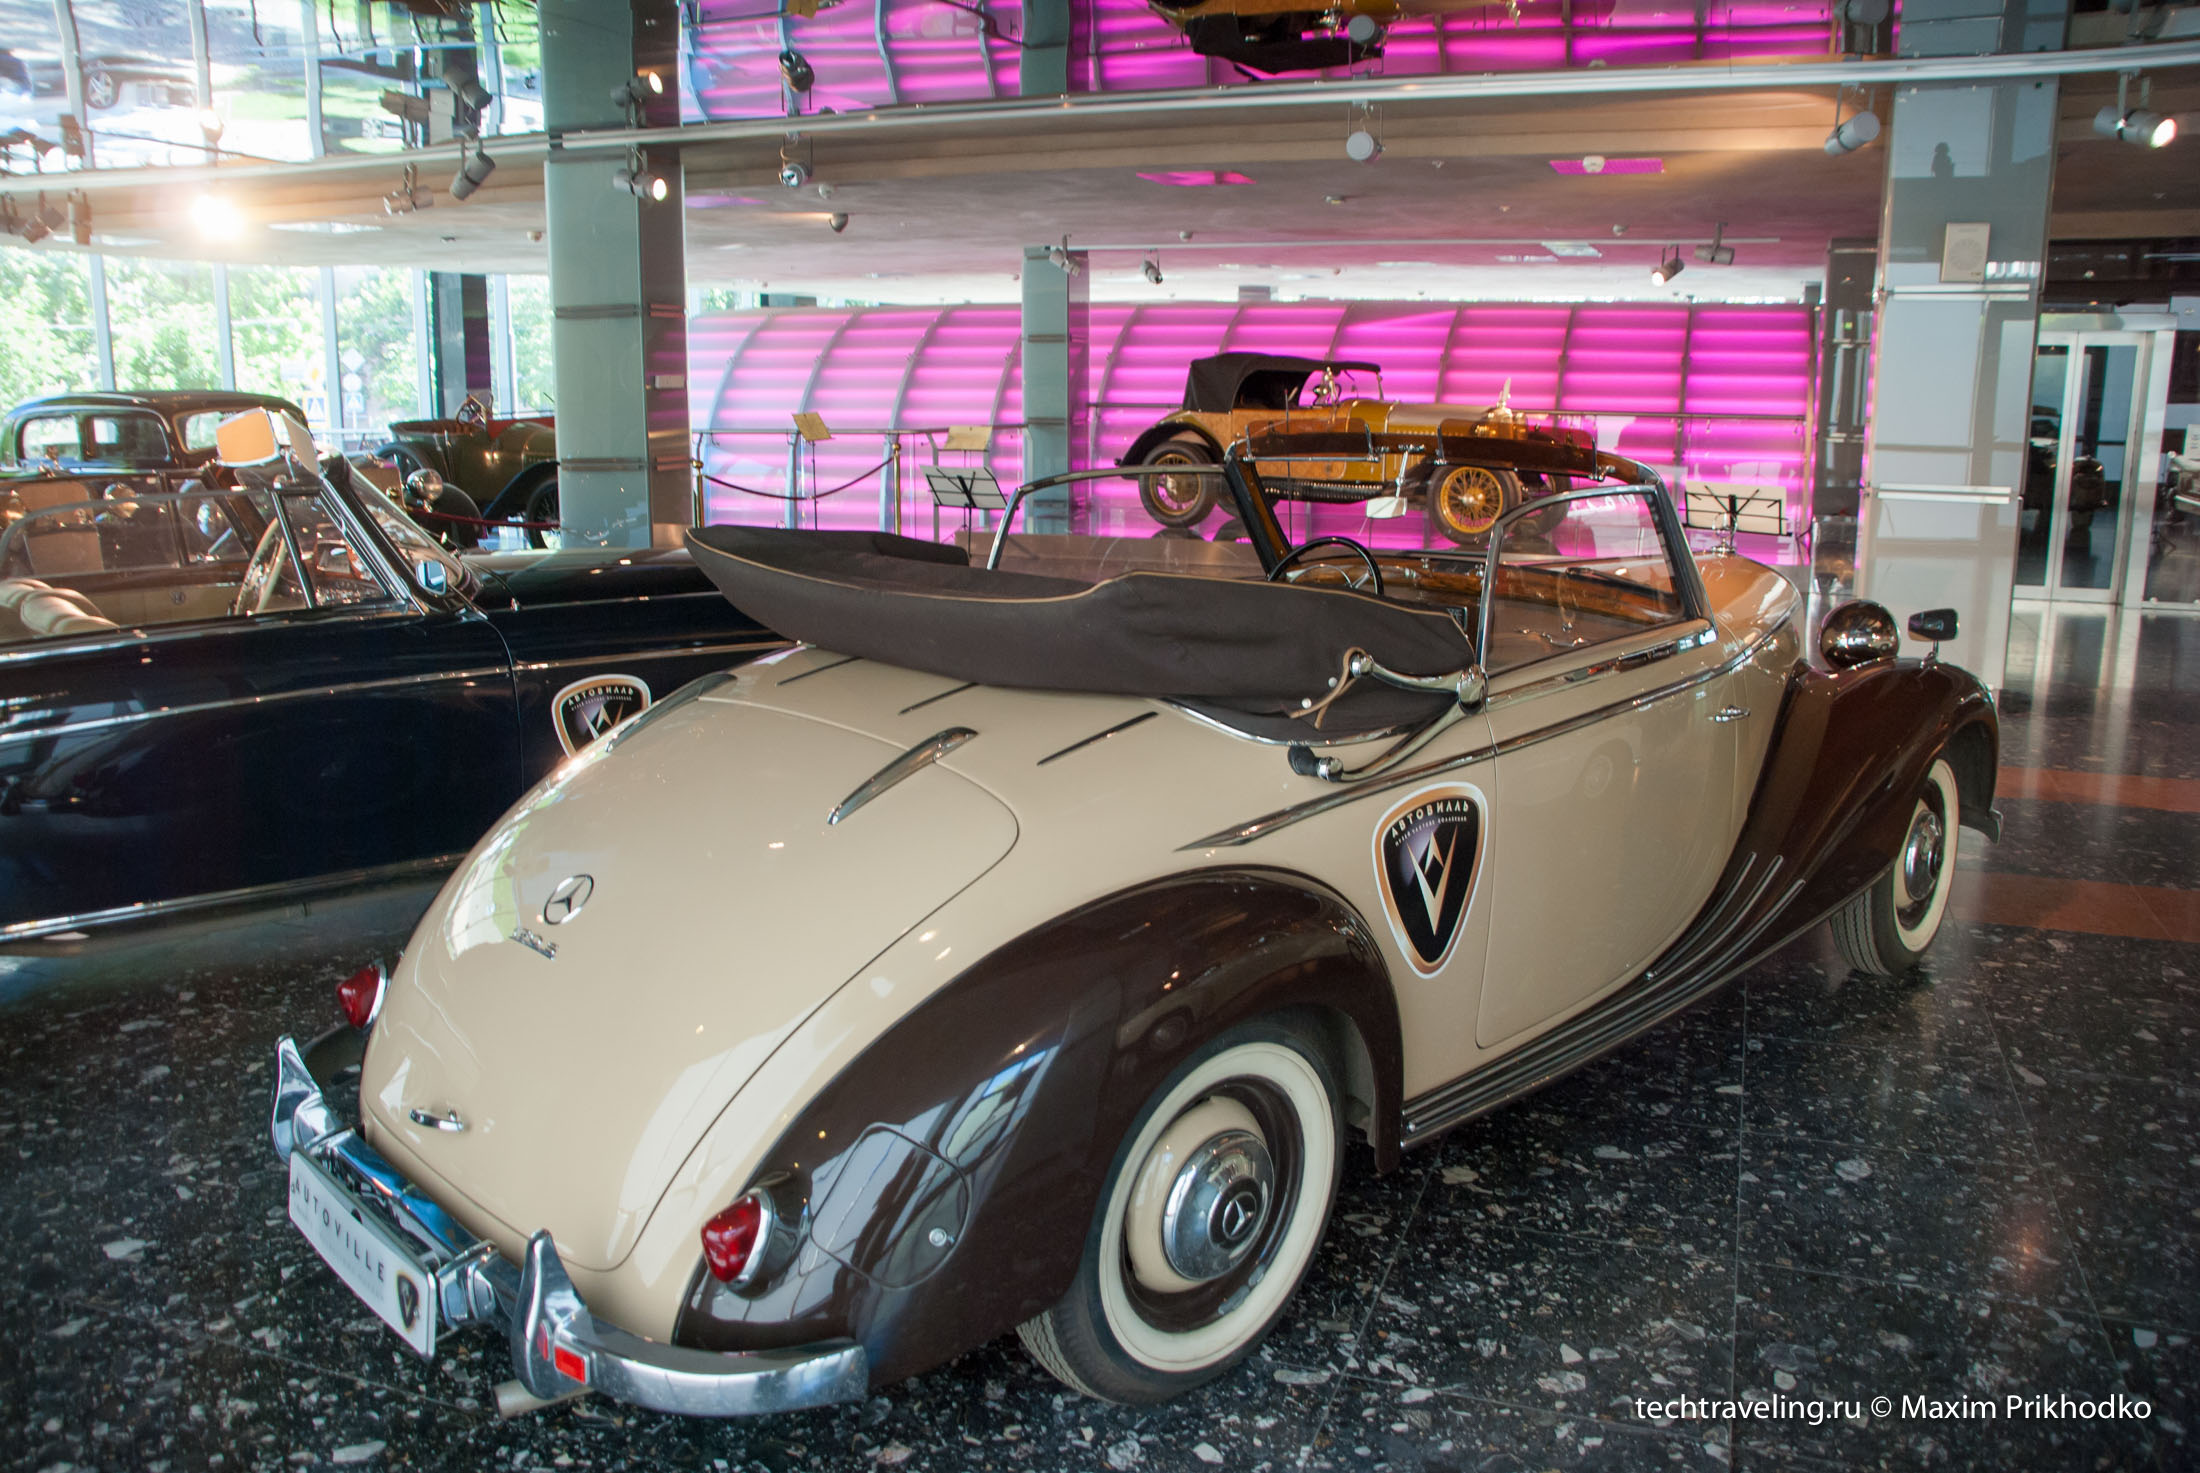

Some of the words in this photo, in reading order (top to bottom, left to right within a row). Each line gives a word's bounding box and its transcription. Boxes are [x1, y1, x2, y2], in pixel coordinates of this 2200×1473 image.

[568, 686, 634, 706] АВТОВИЛЛЬ
[1391, 800, 1469, 838] АВТОВИЛЛЬ
[295, 1176, 385, 1283] AUTOVILLE
